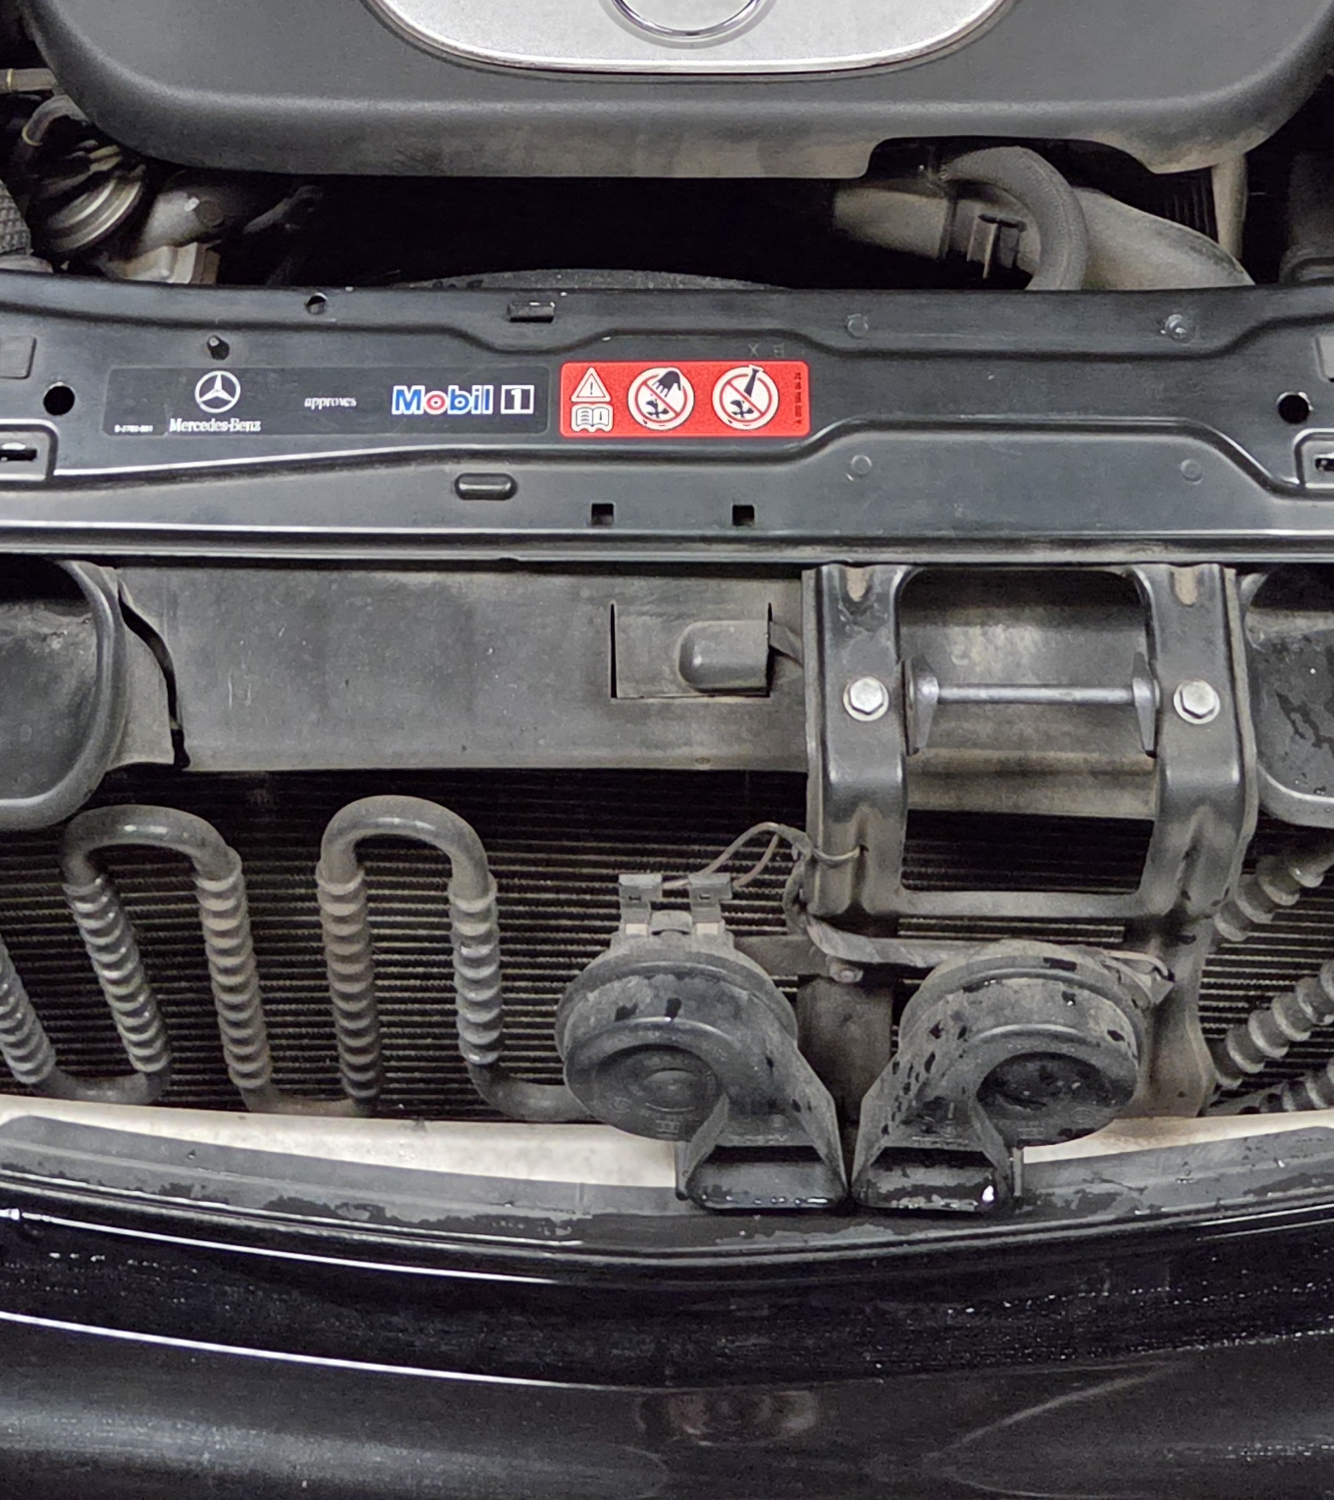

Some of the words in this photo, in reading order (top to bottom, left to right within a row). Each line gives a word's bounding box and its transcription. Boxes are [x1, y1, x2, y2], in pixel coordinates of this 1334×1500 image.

[304, 397, 357, 410] approves
[392, 385, 494, 415] Mobil
[169, 418, 261, 433] Mercedes-Benz
